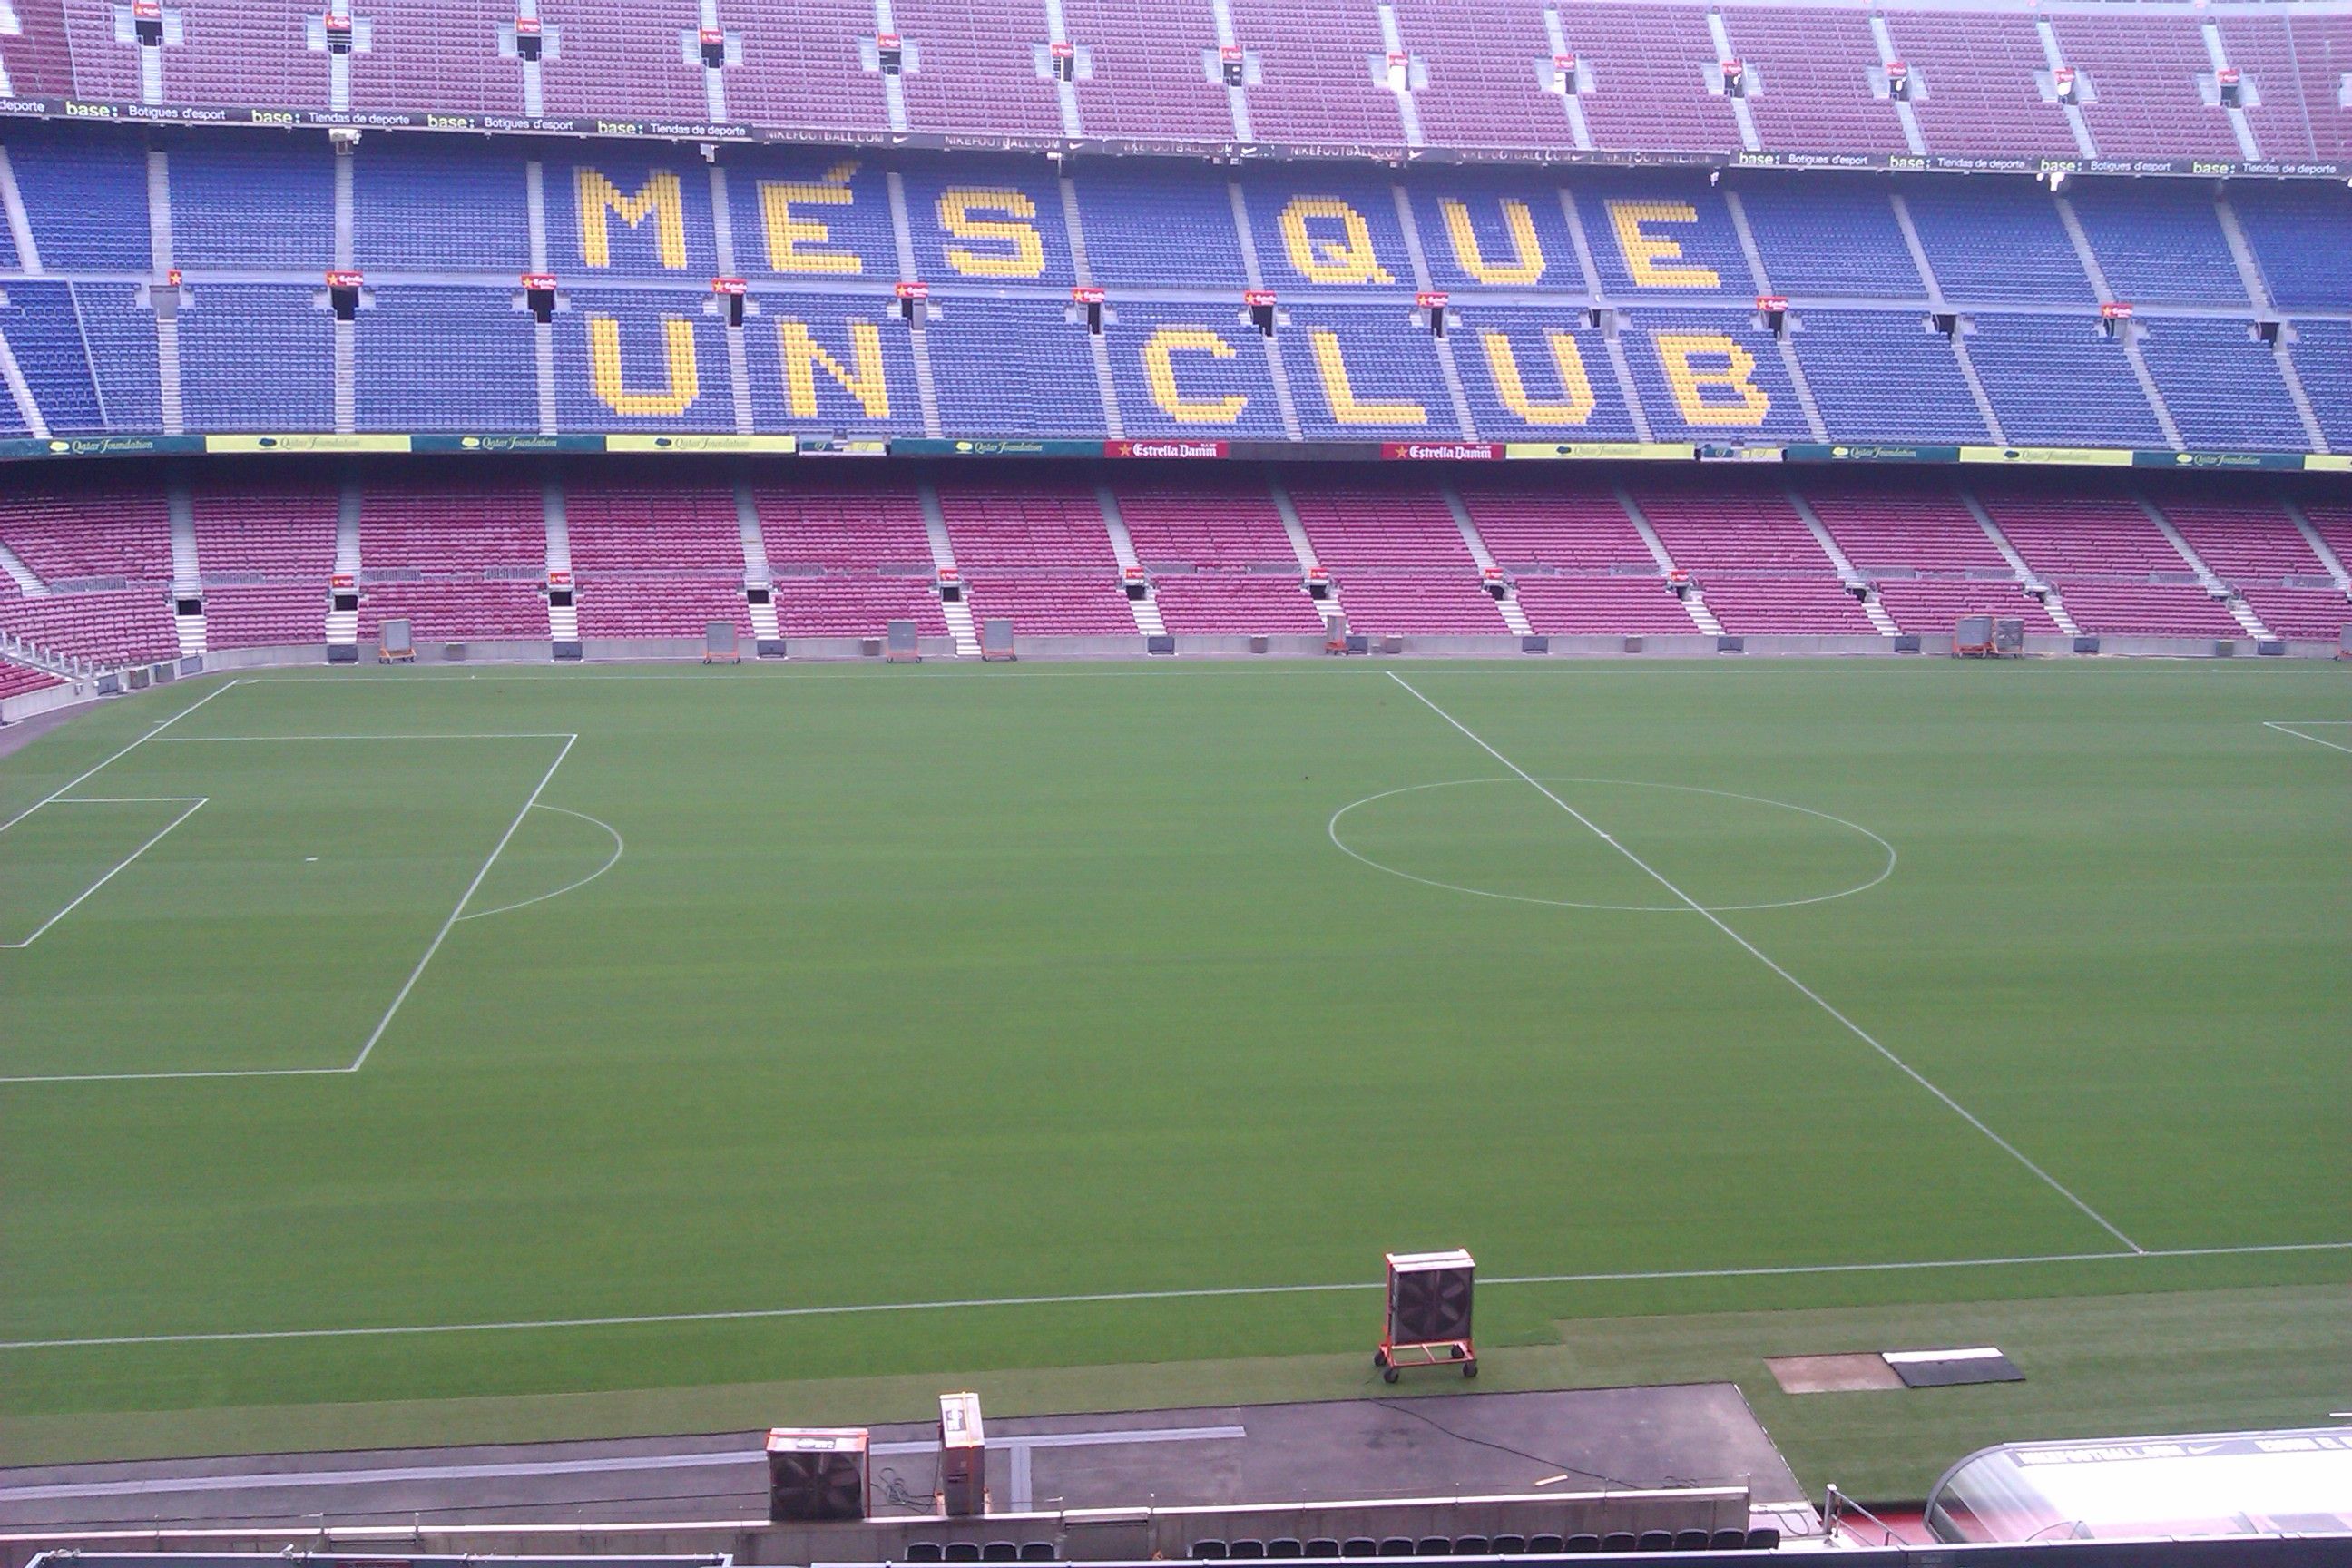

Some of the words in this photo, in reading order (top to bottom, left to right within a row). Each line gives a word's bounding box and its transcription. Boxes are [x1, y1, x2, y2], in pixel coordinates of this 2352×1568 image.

[0, 100, 45, 113] deporte
[128, 105, 179, 119] Botigues
[182, 107, 226, 121] d'esport
[308, 112, 350, 124] Tiendas
[353, 113, 367, 123] de
[369, 114, 410, 126] deporte
[484, 117, 529, 131] Botigues
[534, 119, 573, 132] d'esport
[650, 123, 690, 134] Tiendas
[692, 124, 705, 135] de
[708, 125, 746, 137] deporte
[1278, 194, 1720, 288] QUE
[585, 312, 891, 418] UN
[1141, 325, 1771, 426] CLUB
[1132, 443, 1179, 456] Estrella
[1179, 444, 1217, 458] Damm
[1409, 446, 1454, 459] Estrella
[1455, 446, 1492, 459] Damm
